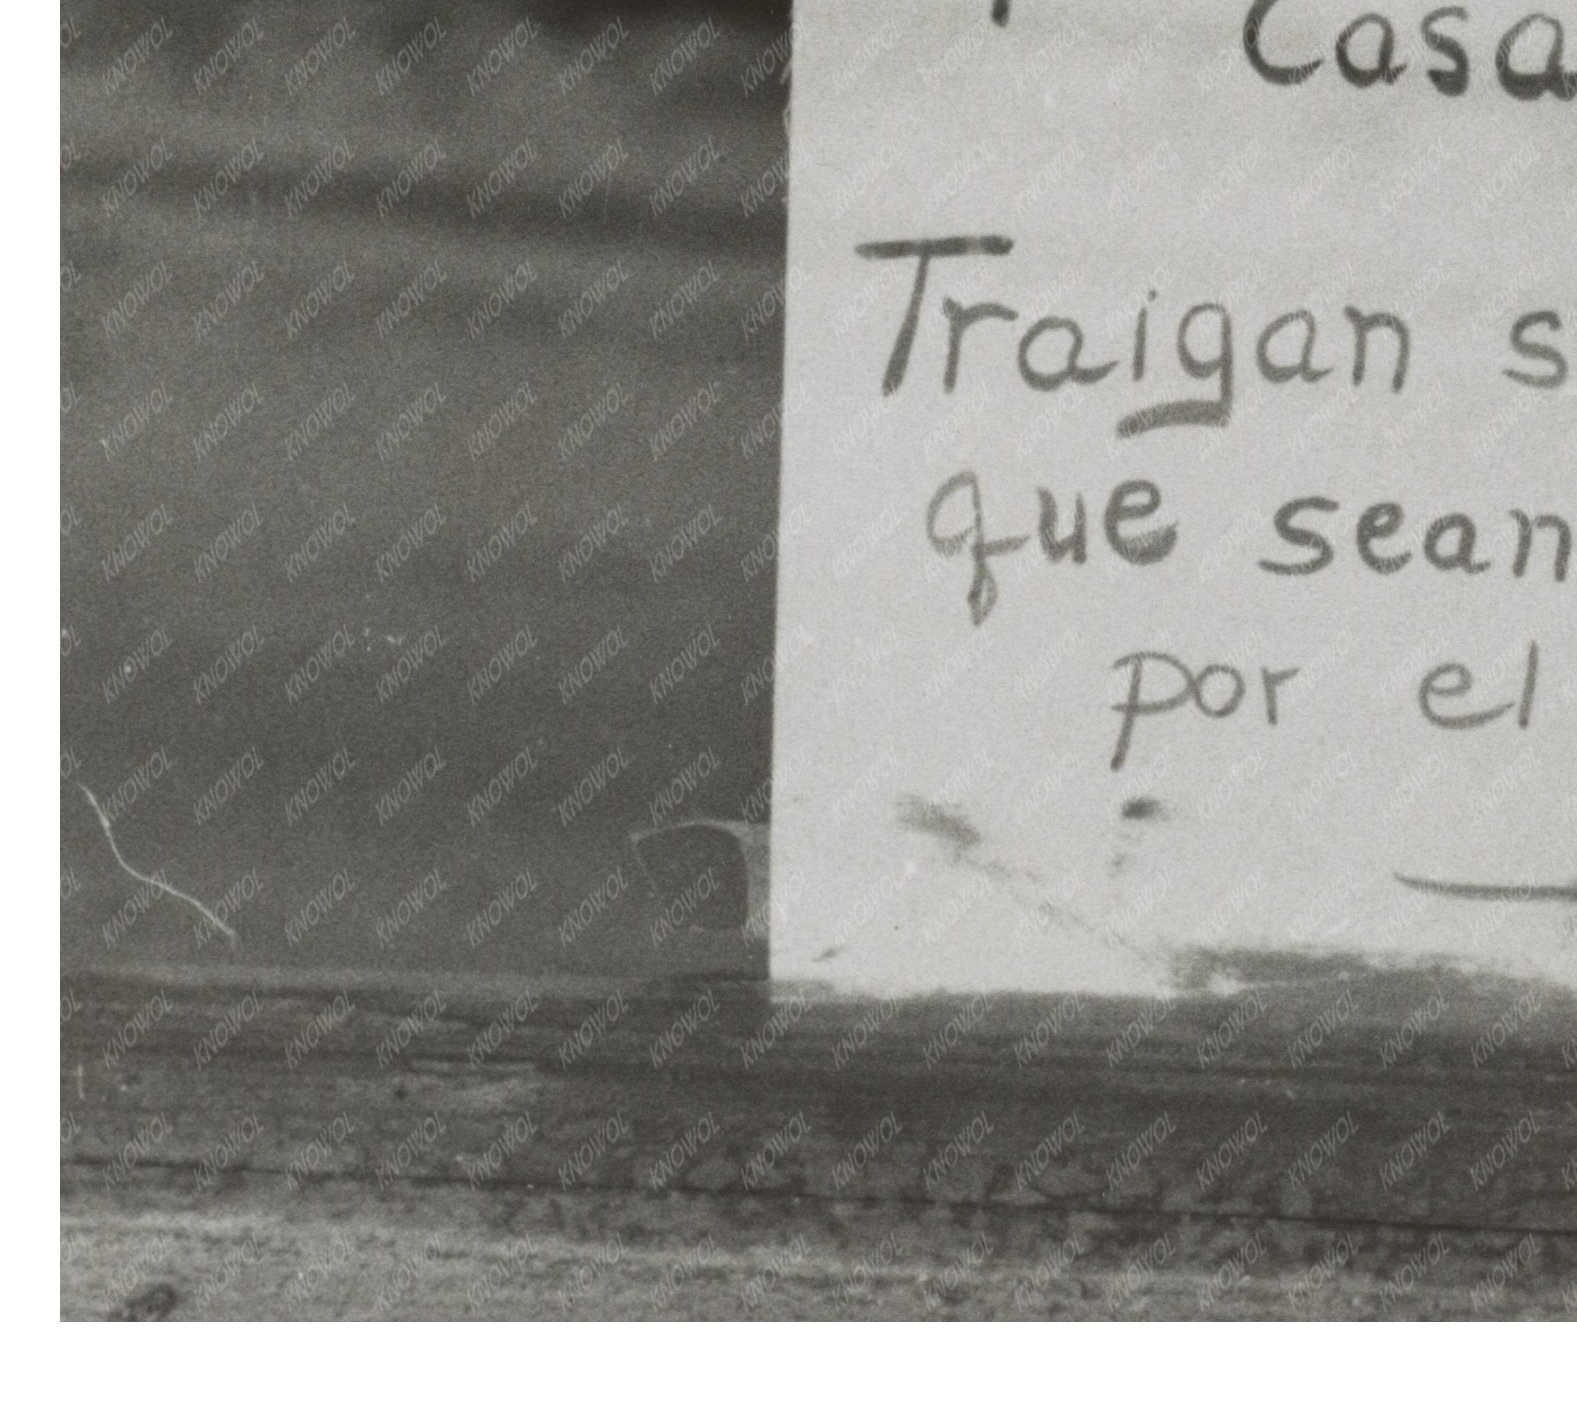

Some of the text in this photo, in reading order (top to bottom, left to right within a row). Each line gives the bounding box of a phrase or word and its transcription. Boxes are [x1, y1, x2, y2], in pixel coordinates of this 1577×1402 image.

[854, 231, 1412, 439] Traigan
[925, 470, 1179, 626] que
[1258, 493, 1575, 583] sean
[1107, 649, 1298, 774] por
[1414, 641, 1542, 734] el
